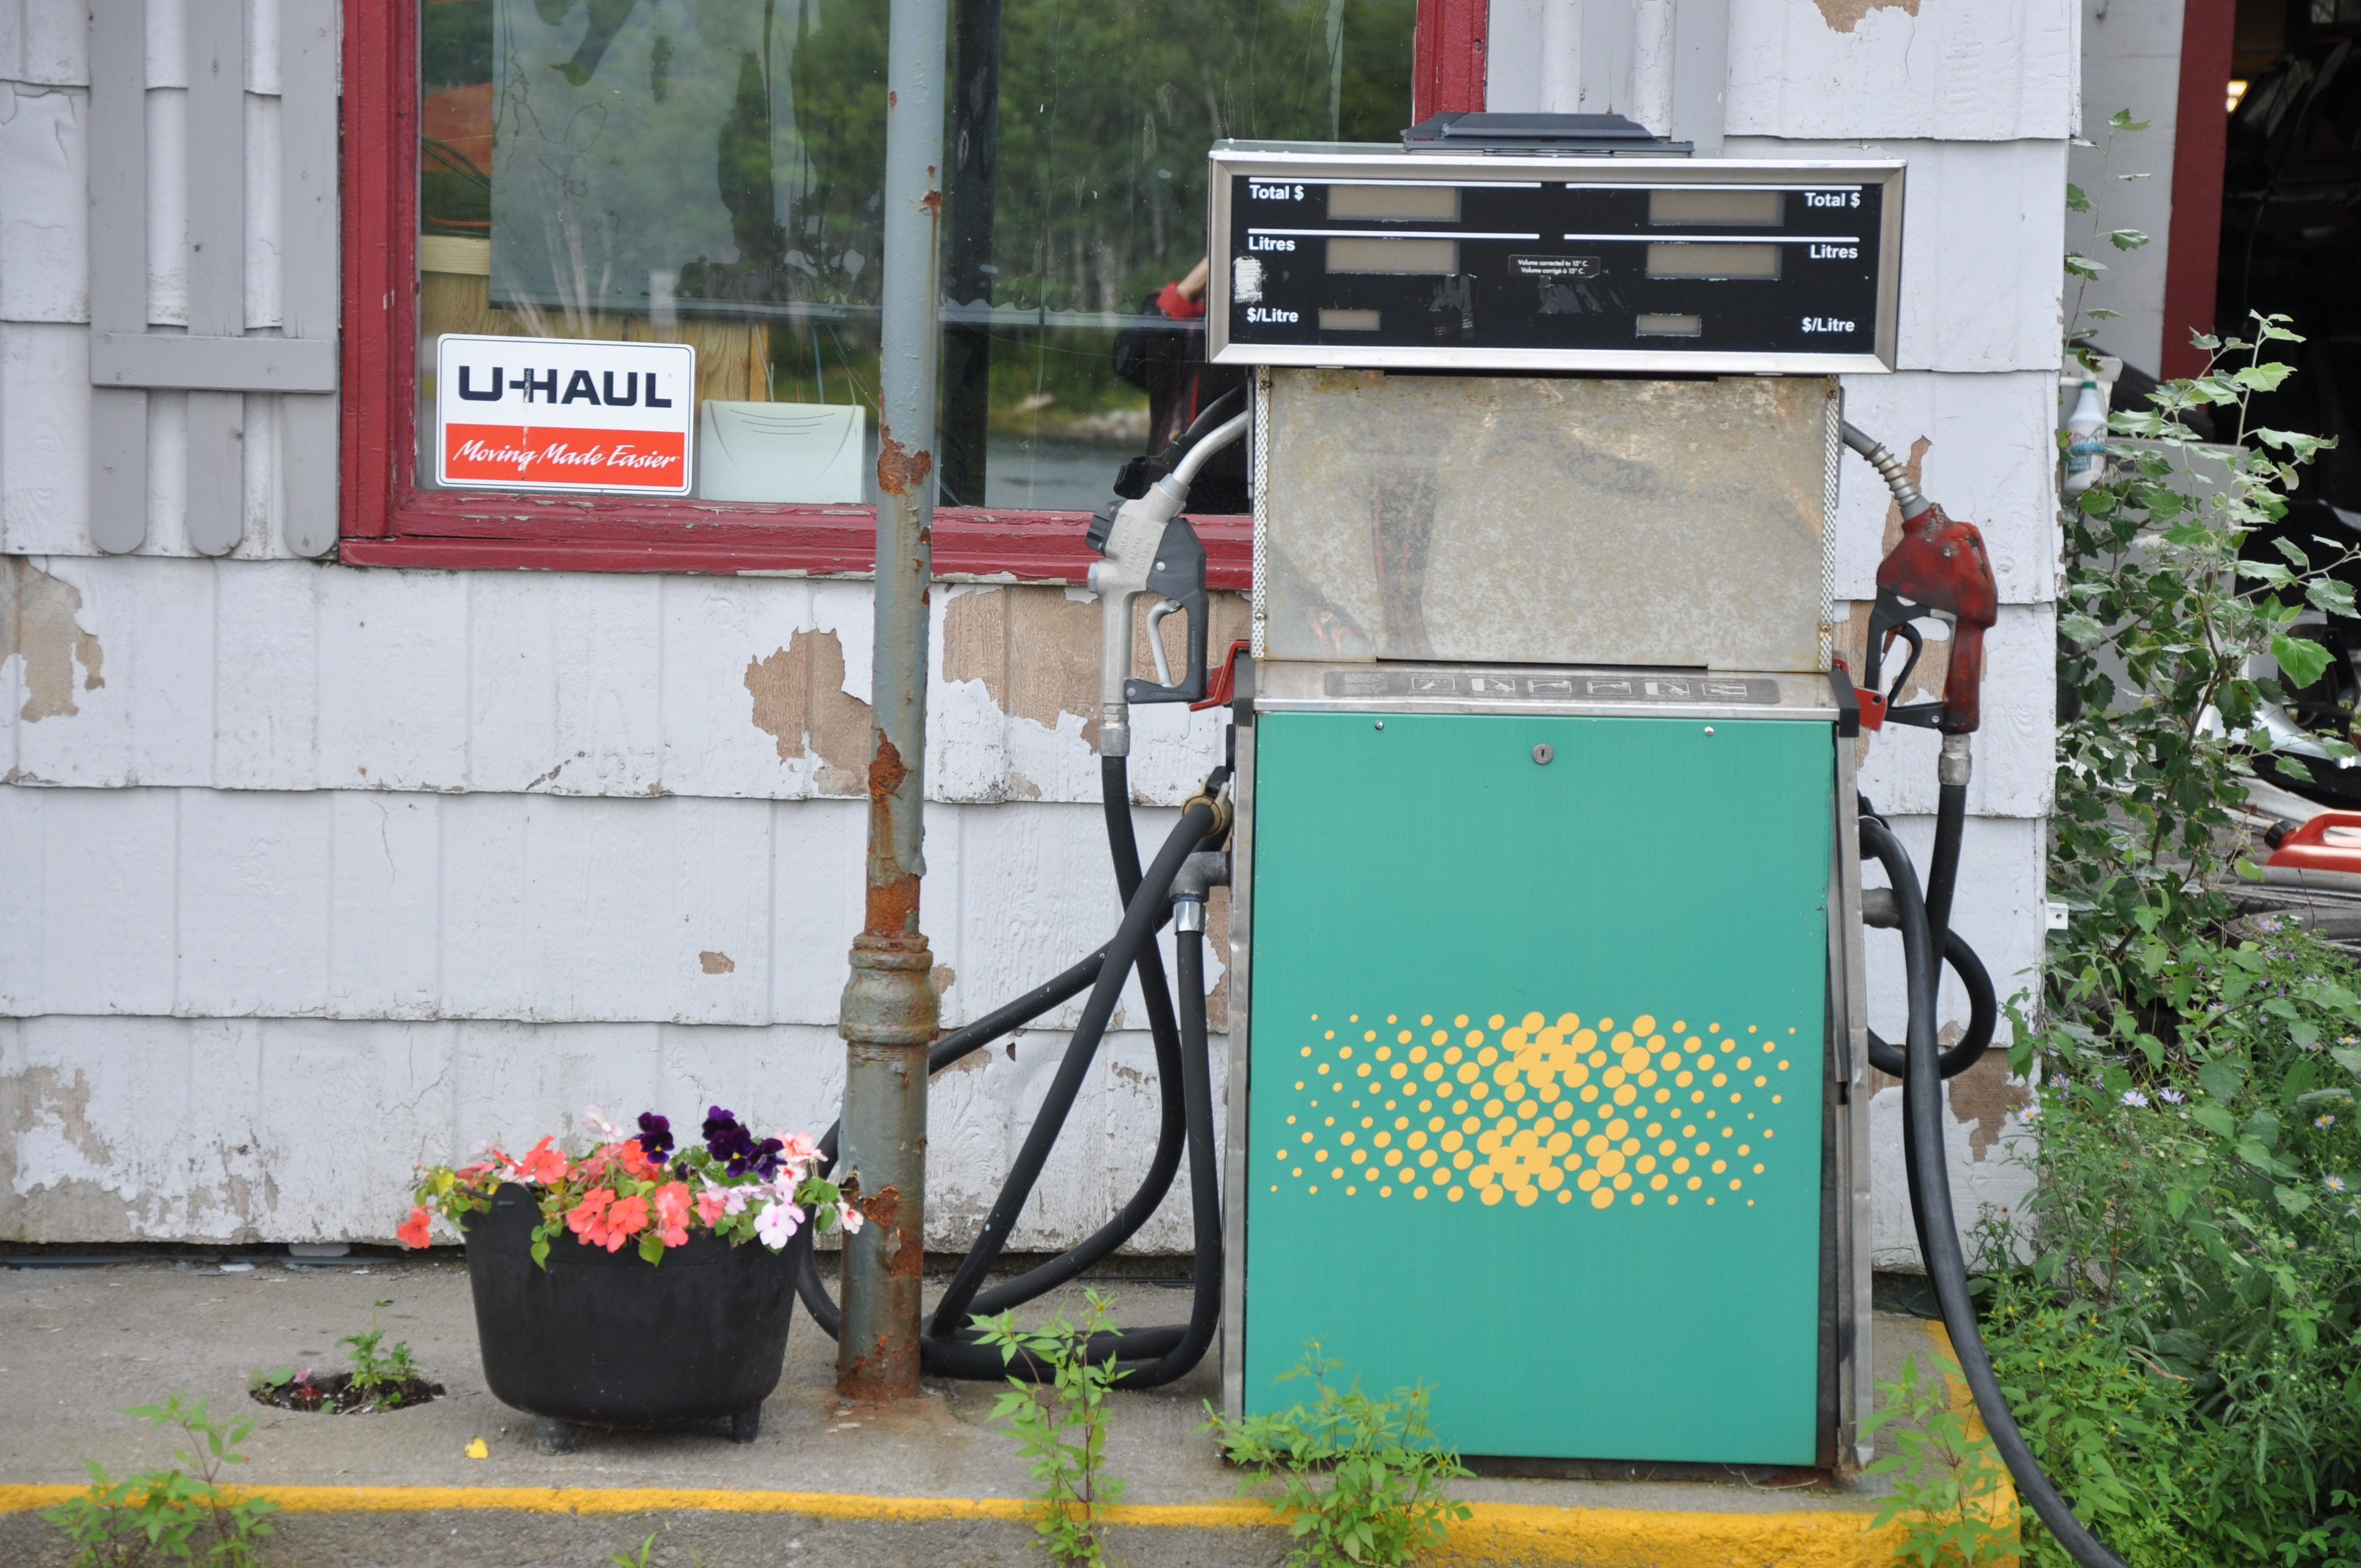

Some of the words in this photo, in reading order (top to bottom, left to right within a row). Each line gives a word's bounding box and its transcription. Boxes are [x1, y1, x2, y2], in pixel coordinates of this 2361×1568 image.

[1249, 185, 1290, 200] Total
[1294, 184, 1304, 202] $
[1804, 192, 1846, 207] Total
[1850, 192, 1860, 208] $
[1248, 236, 1296, 251] Litres
[1810, 244, 1858, 259] Litres
[1247, 307, 1299, 323] $/Litre
[1802, 317, 1855, 333] $/Litre
[459, 366, 672, 408] U-HAUL
[453, 439, 537, 472] Moving
[536, 443, 606, 466] Made
[606, 445, 677, 468] Easier
